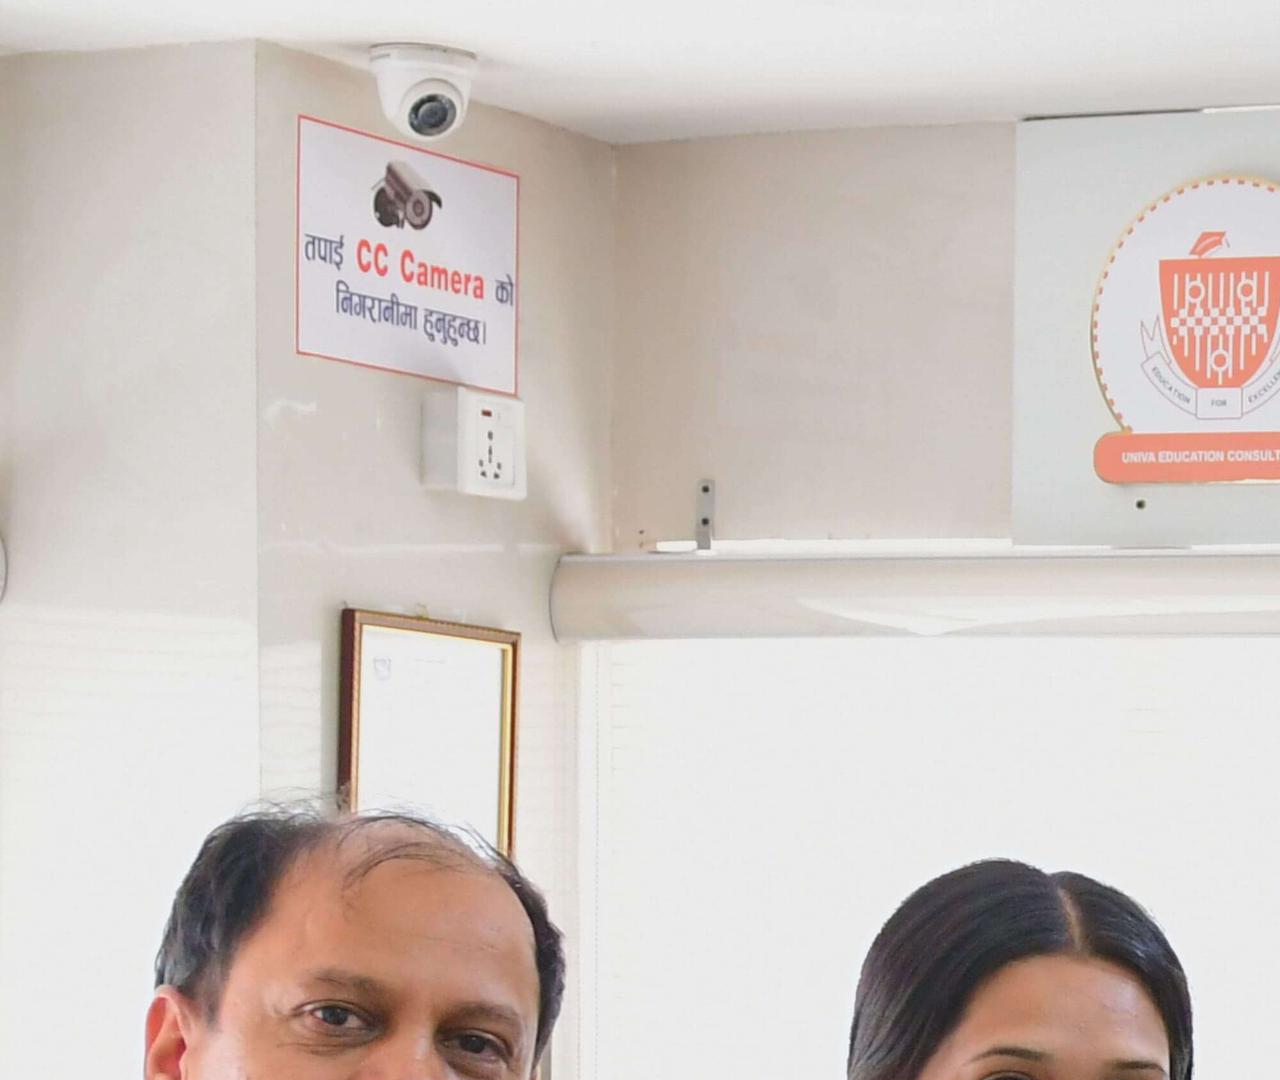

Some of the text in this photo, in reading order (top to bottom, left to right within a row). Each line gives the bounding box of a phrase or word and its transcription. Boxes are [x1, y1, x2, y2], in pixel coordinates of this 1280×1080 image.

[356, 239, 389, 276] CC
[400, 249, 484, 299] Camera
[495, 274, 515, 306] को
[336, 280, 486, 347] निगरानीमा हुनुहुन्छ।
[1152, 366, 1190, 403] EDUCATION
[1121, 452, 1156, 463] UNIVA
[1158, 450, 1224, 463] EDUCATION
